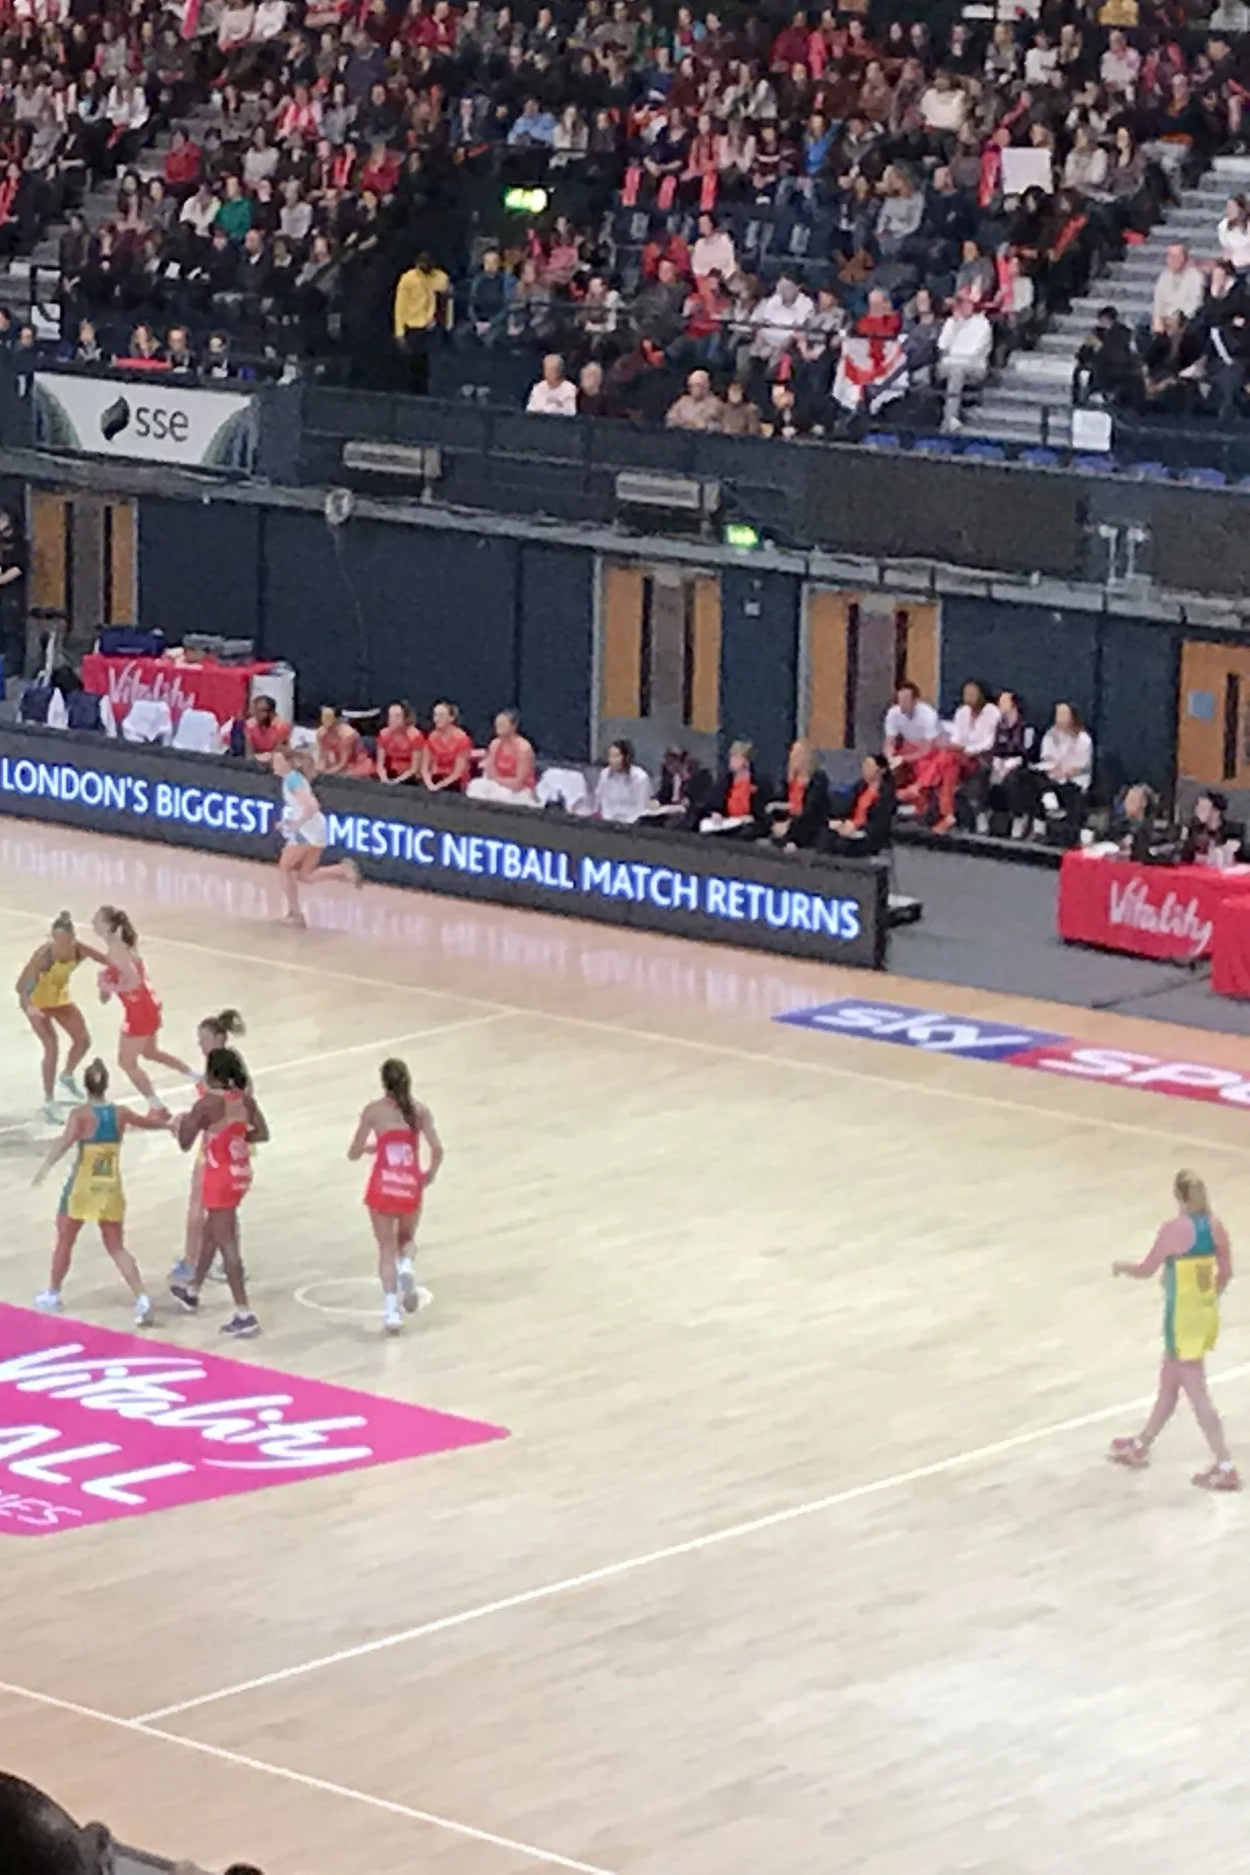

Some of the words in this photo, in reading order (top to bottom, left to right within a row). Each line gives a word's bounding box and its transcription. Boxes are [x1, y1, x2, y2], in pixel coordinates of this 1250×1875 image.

[135, 406, 189, 442] sse
[2, 758, 148, 814] LONDON'S
[157, 788, 275, 836] BIGGEST
[327, 813, 435, 864] MESTIC
[442, 837, 575, 890] NETBALL
[582, 857, 699, 912] MATCH
[706, 878, 861, 940] RETURNS
[1109, 876, 1213, 955] Vitality
[813, 1006, 1032, 1050] sky
